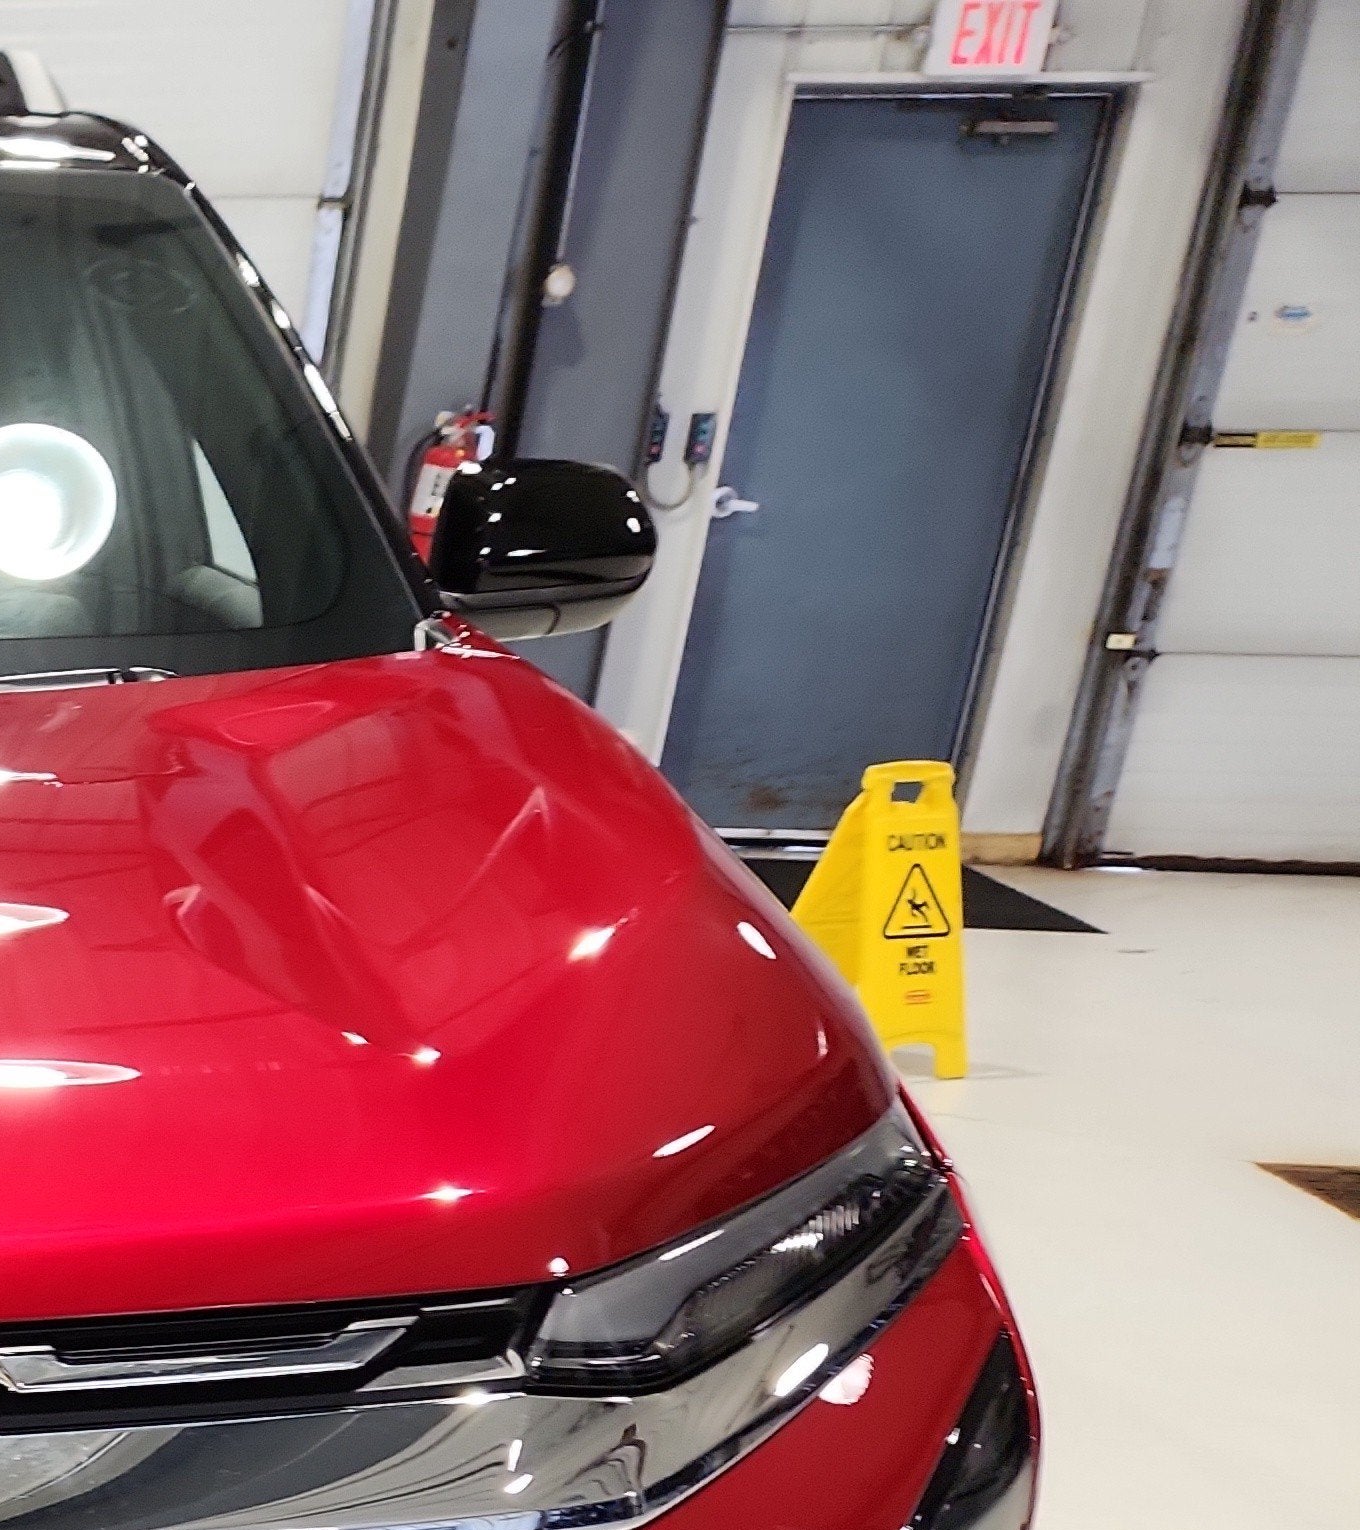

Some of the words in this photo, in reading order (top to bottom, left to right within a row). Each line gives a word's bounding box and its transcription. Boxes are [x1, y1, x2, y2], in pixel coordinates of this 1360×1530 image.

[950, 1, 1041, 64] EXIT
[887, 833, 946, 851] CAUTION
[906, 945, 929, 958] WET
[899, 961, 935, 975] FLOOR
